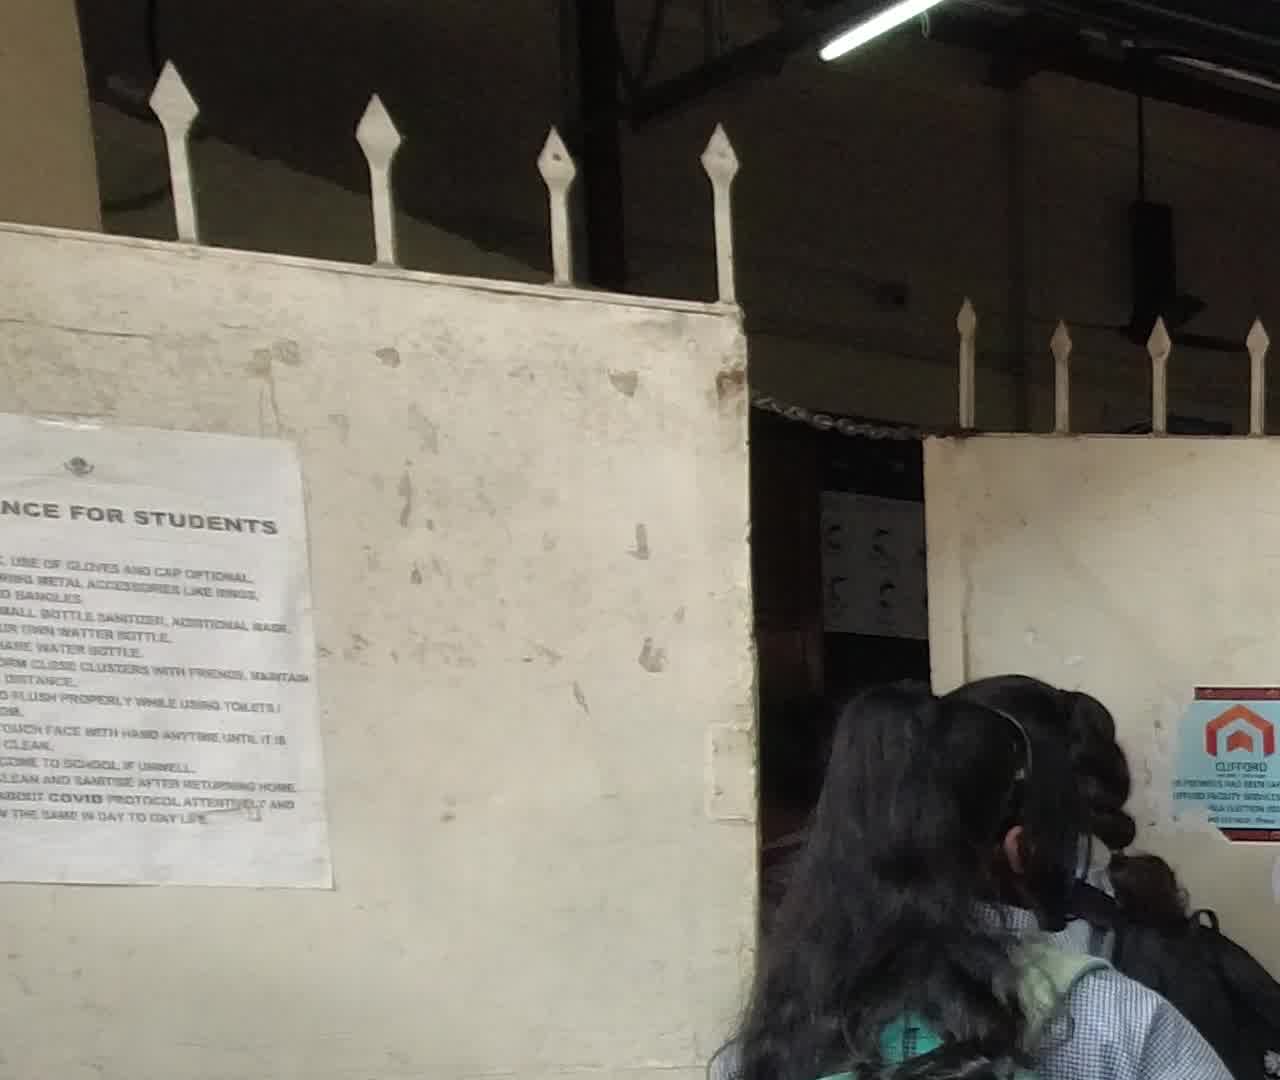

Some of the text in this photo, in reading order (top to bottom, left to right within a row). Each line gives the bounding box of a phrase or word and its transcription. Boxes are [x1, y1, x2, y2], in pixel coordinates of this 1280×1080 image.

[70, 505, 125, 523] FOR
[134, 510, 279, 535] STUDENTS
[66, 560, 120, 574] GLOVES
[63, 759, 120, 771] SCHOOL
[1215, 761, 1268, 773] CLIFFORD
[48, 793, 103, 805] COVID
